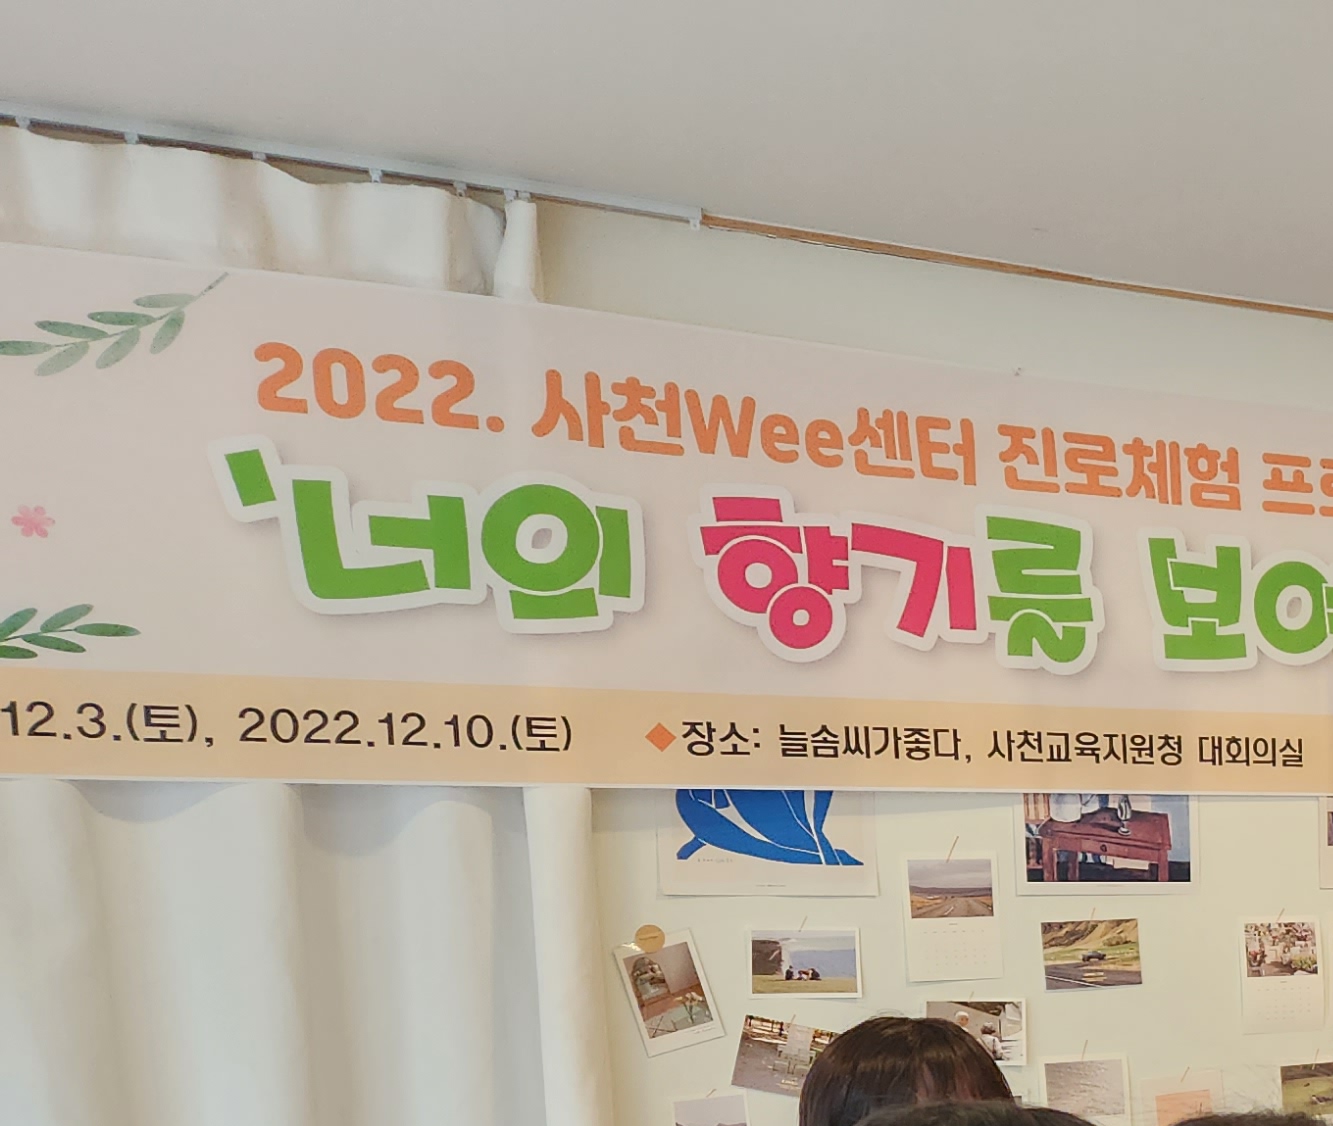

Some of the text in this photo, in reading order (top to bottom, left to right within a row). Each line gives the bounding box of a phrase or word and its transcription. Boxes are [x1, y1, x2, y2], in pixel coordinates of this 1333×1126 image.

[254, 341, 505, 432] 2022.
[531, 368, 976, 486] 사천Wee센터
[998, 423, 1242, 511] 진로체험
[699, 496, 1094, 664] 향기를
[237, 706, 573, 753] 2022.12.10.(토)
[680, 720, 1304, 768] 장소: 늘솜씨가좋다, 사천교육지원청 대회의실
